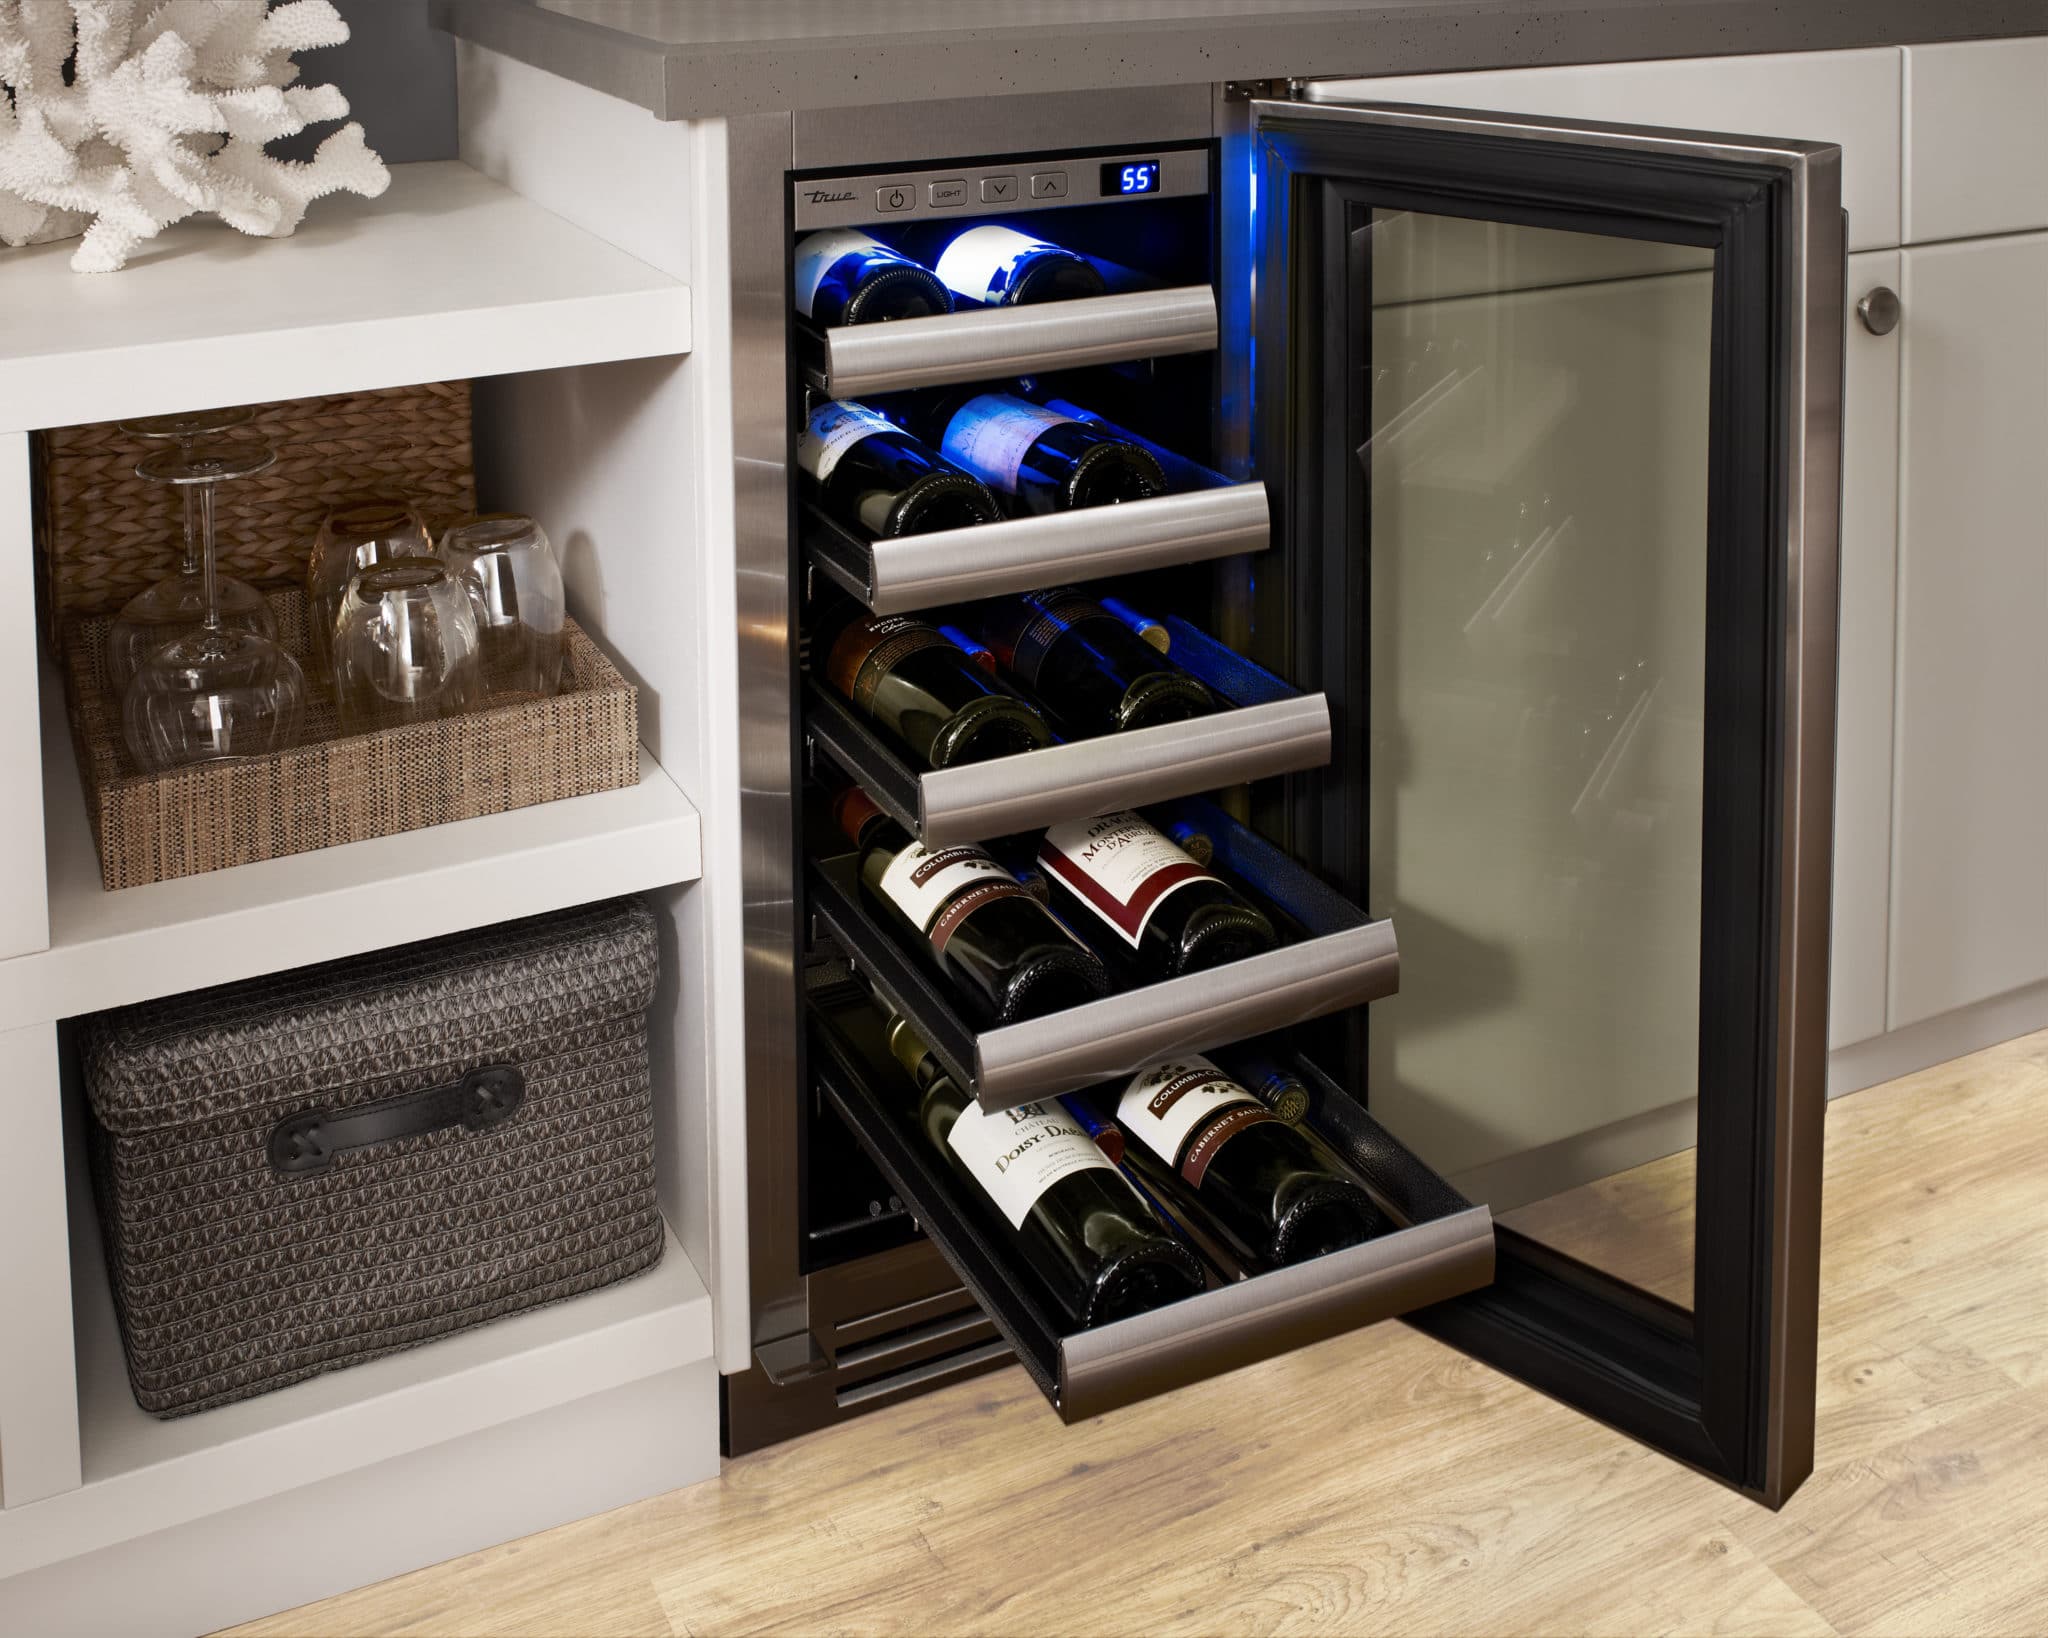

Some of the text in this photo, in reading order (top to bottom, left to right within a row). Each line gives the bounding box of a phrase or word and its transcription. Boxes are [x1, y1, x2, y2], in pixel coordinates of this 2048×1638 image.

[936, 190, 962, 199] LIGHT
[940, 886, 991, 928] CABERNET
[1190, 1114, 1235, 1164] CABERNET
